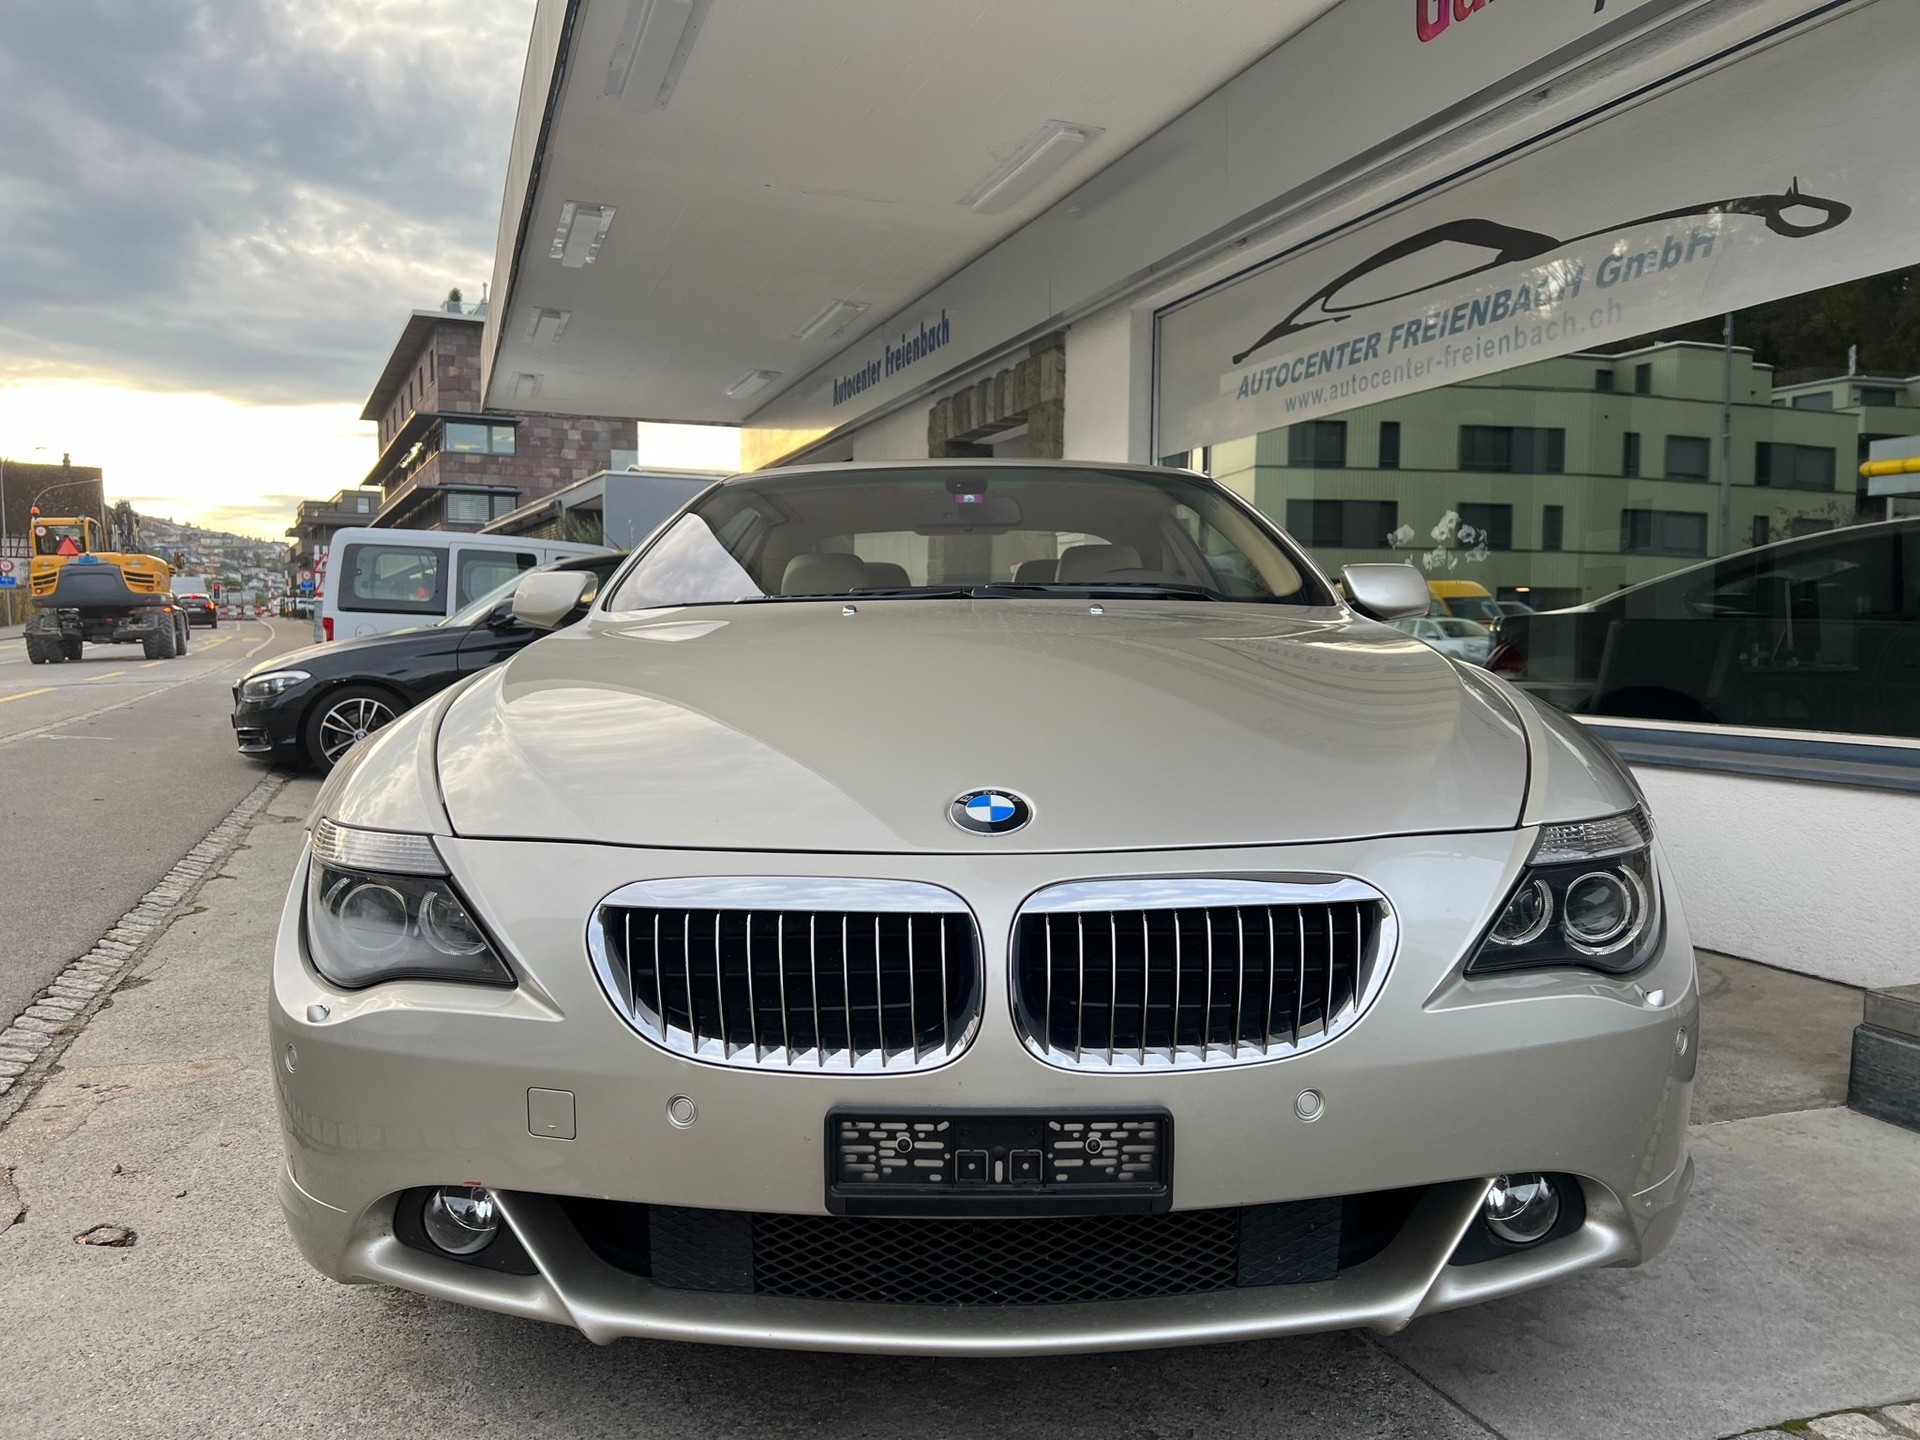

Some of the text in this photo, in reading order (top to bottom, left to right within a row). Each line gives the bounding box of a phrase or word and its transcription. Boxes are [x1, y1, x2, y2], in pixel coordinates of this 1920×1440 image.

[833, 307, 950, 407] Autocenter Freienbach
[1236, 229, 1717, 400] AUTOCENTER FREIENBACH GmbH
[1284, 298, 1623, 413] www.autocenter-freienbach.ch
[959, 790, 1022, 803] BMW
